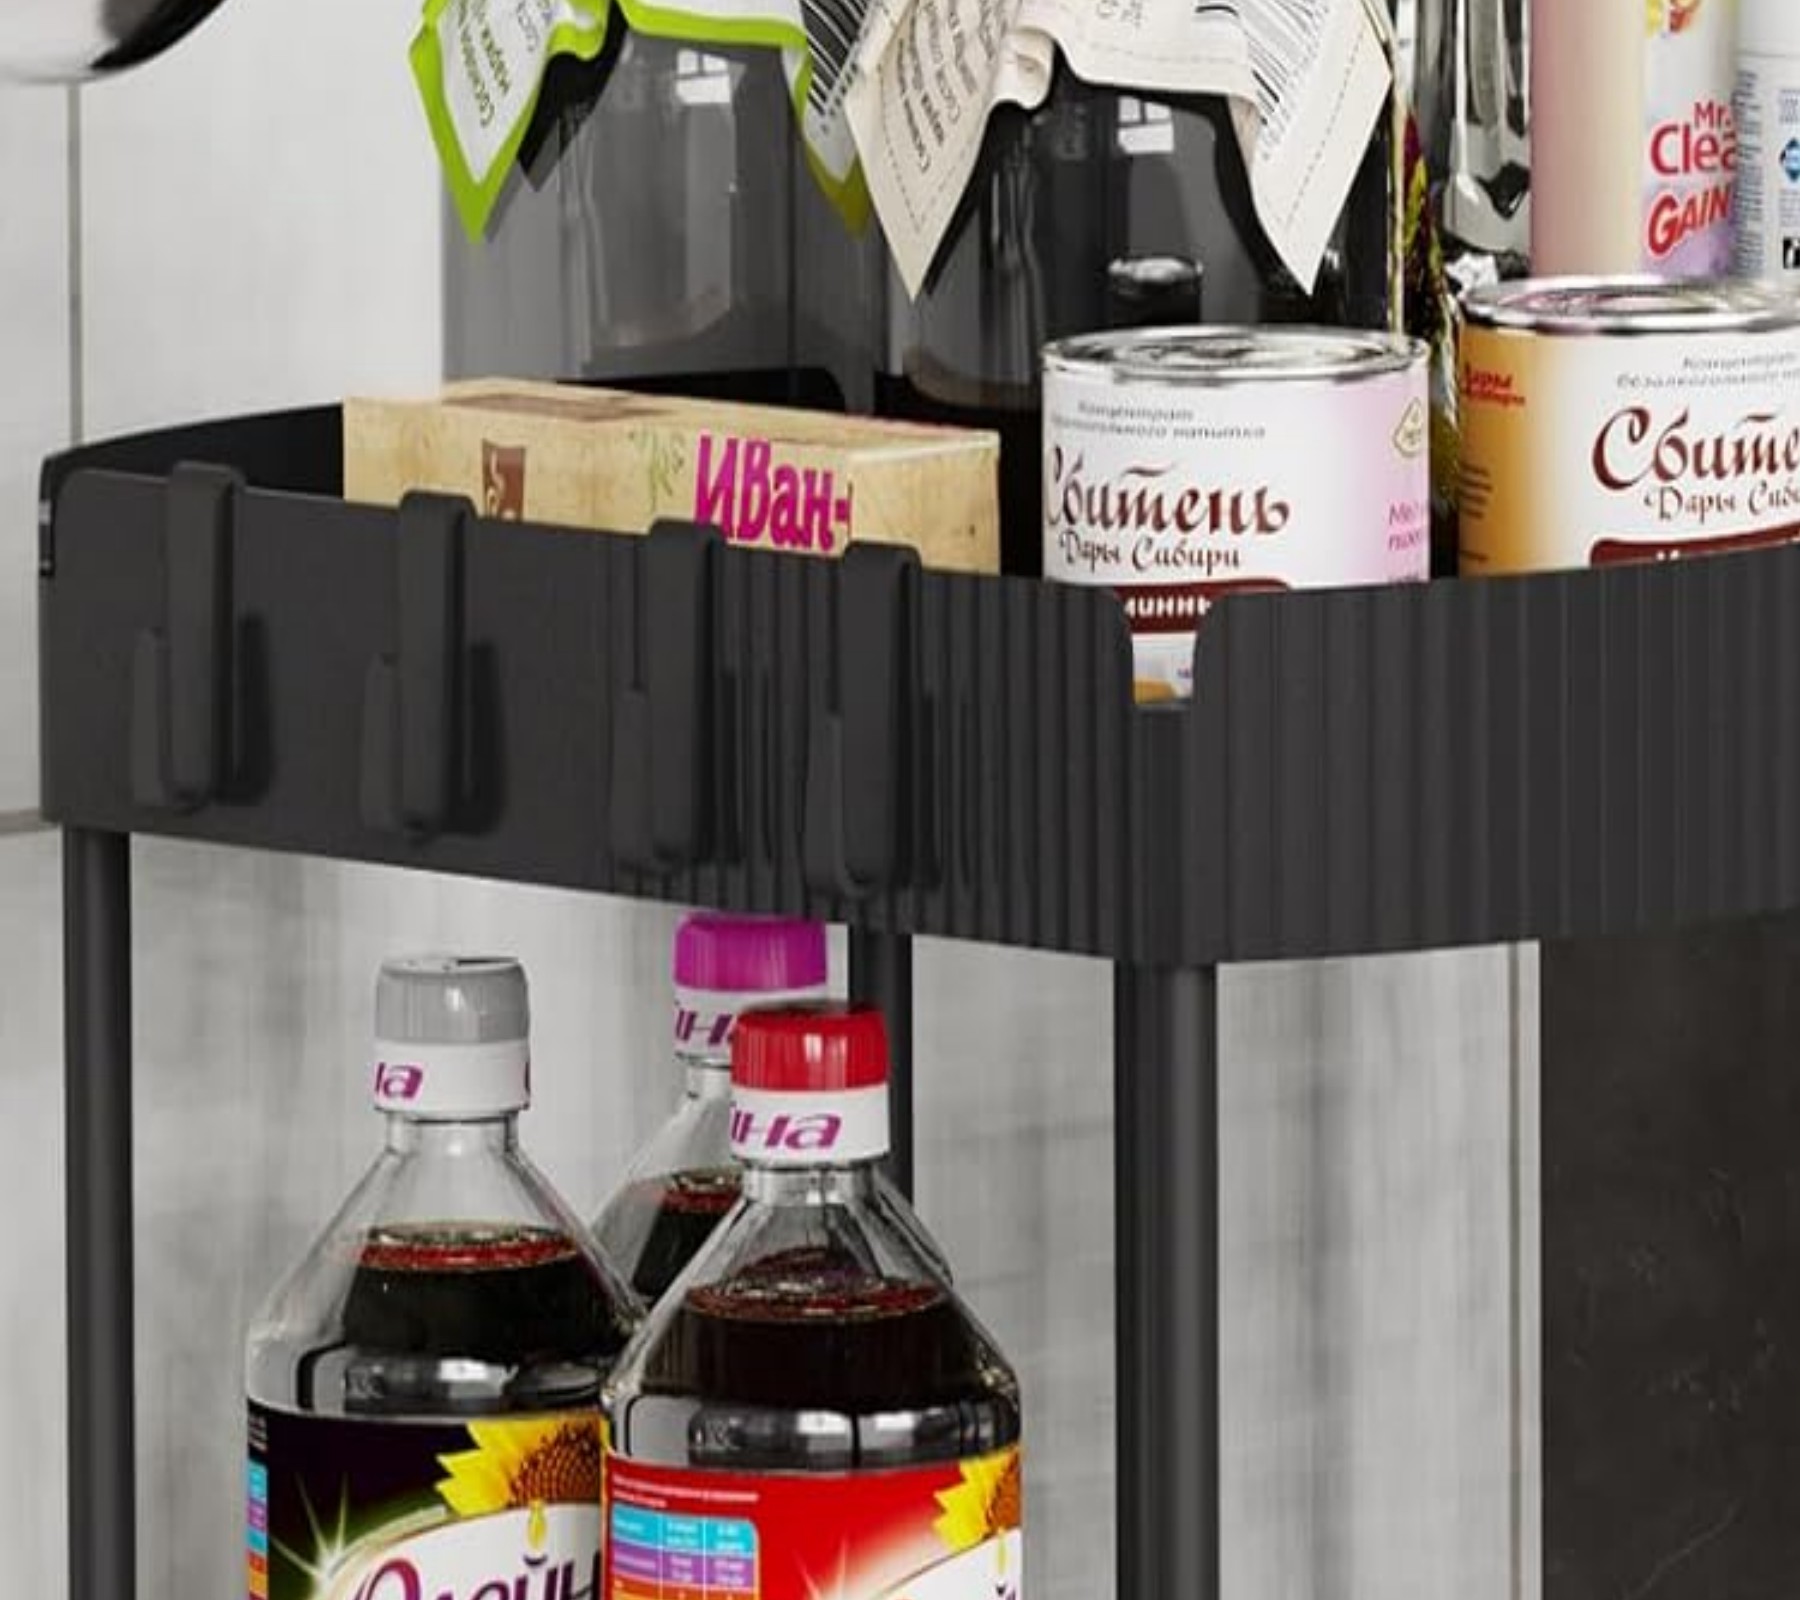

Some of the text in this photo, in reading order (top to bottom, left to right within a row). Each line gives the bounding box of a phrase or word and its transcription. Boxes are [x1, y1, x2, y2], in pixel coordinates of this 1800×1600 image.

[1644, 485, 1737, 524] Дары
[1059, 529, 1242, 576] Дары Сибири
